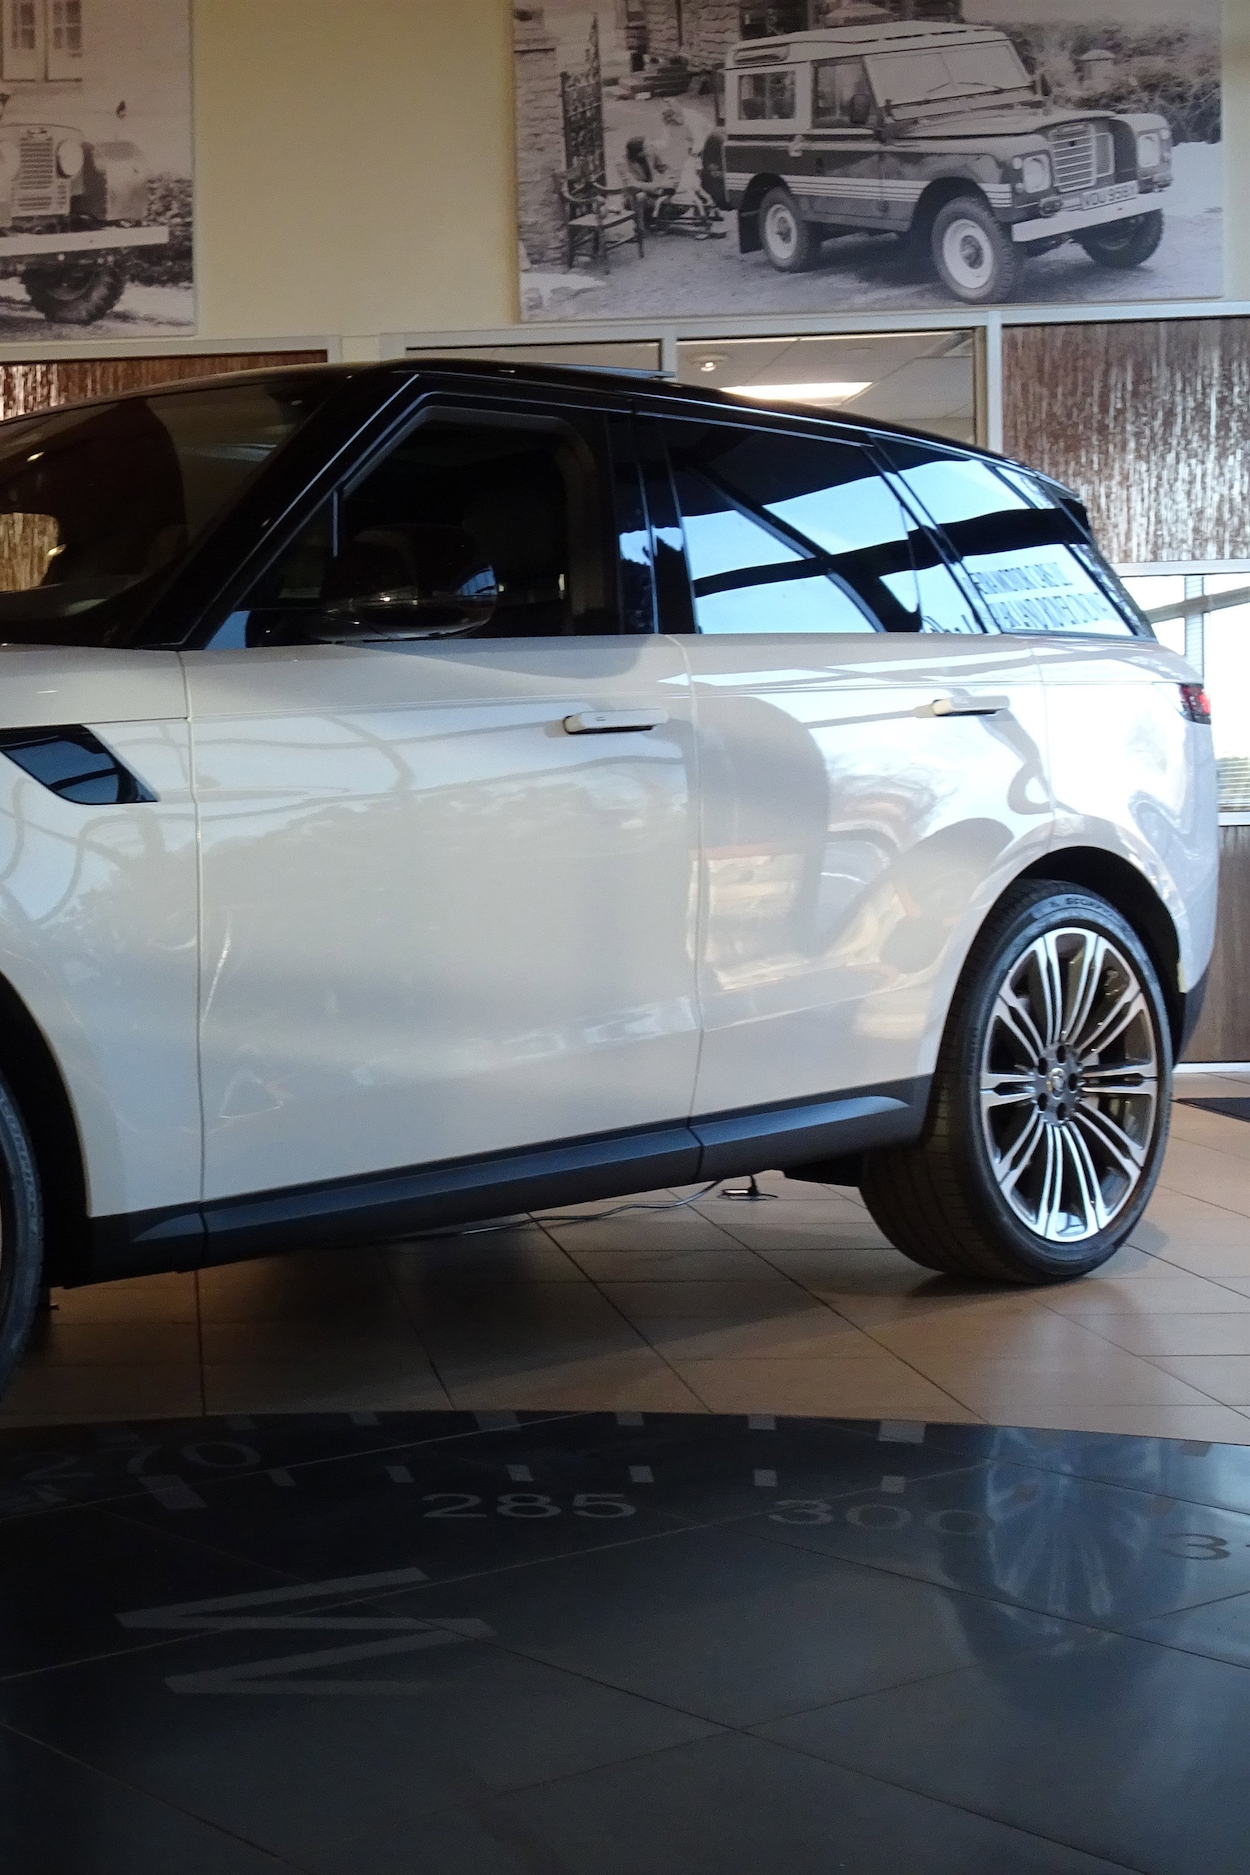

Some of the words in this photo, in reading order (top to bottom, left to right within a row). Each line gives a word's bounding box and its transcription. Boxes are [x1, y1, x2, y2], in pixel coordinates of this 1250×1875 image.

[422, 1492, 639, 1519] 285
[768, 1499, 996, 1535] 300
[1160, 1532, 1250, 1561] 3
